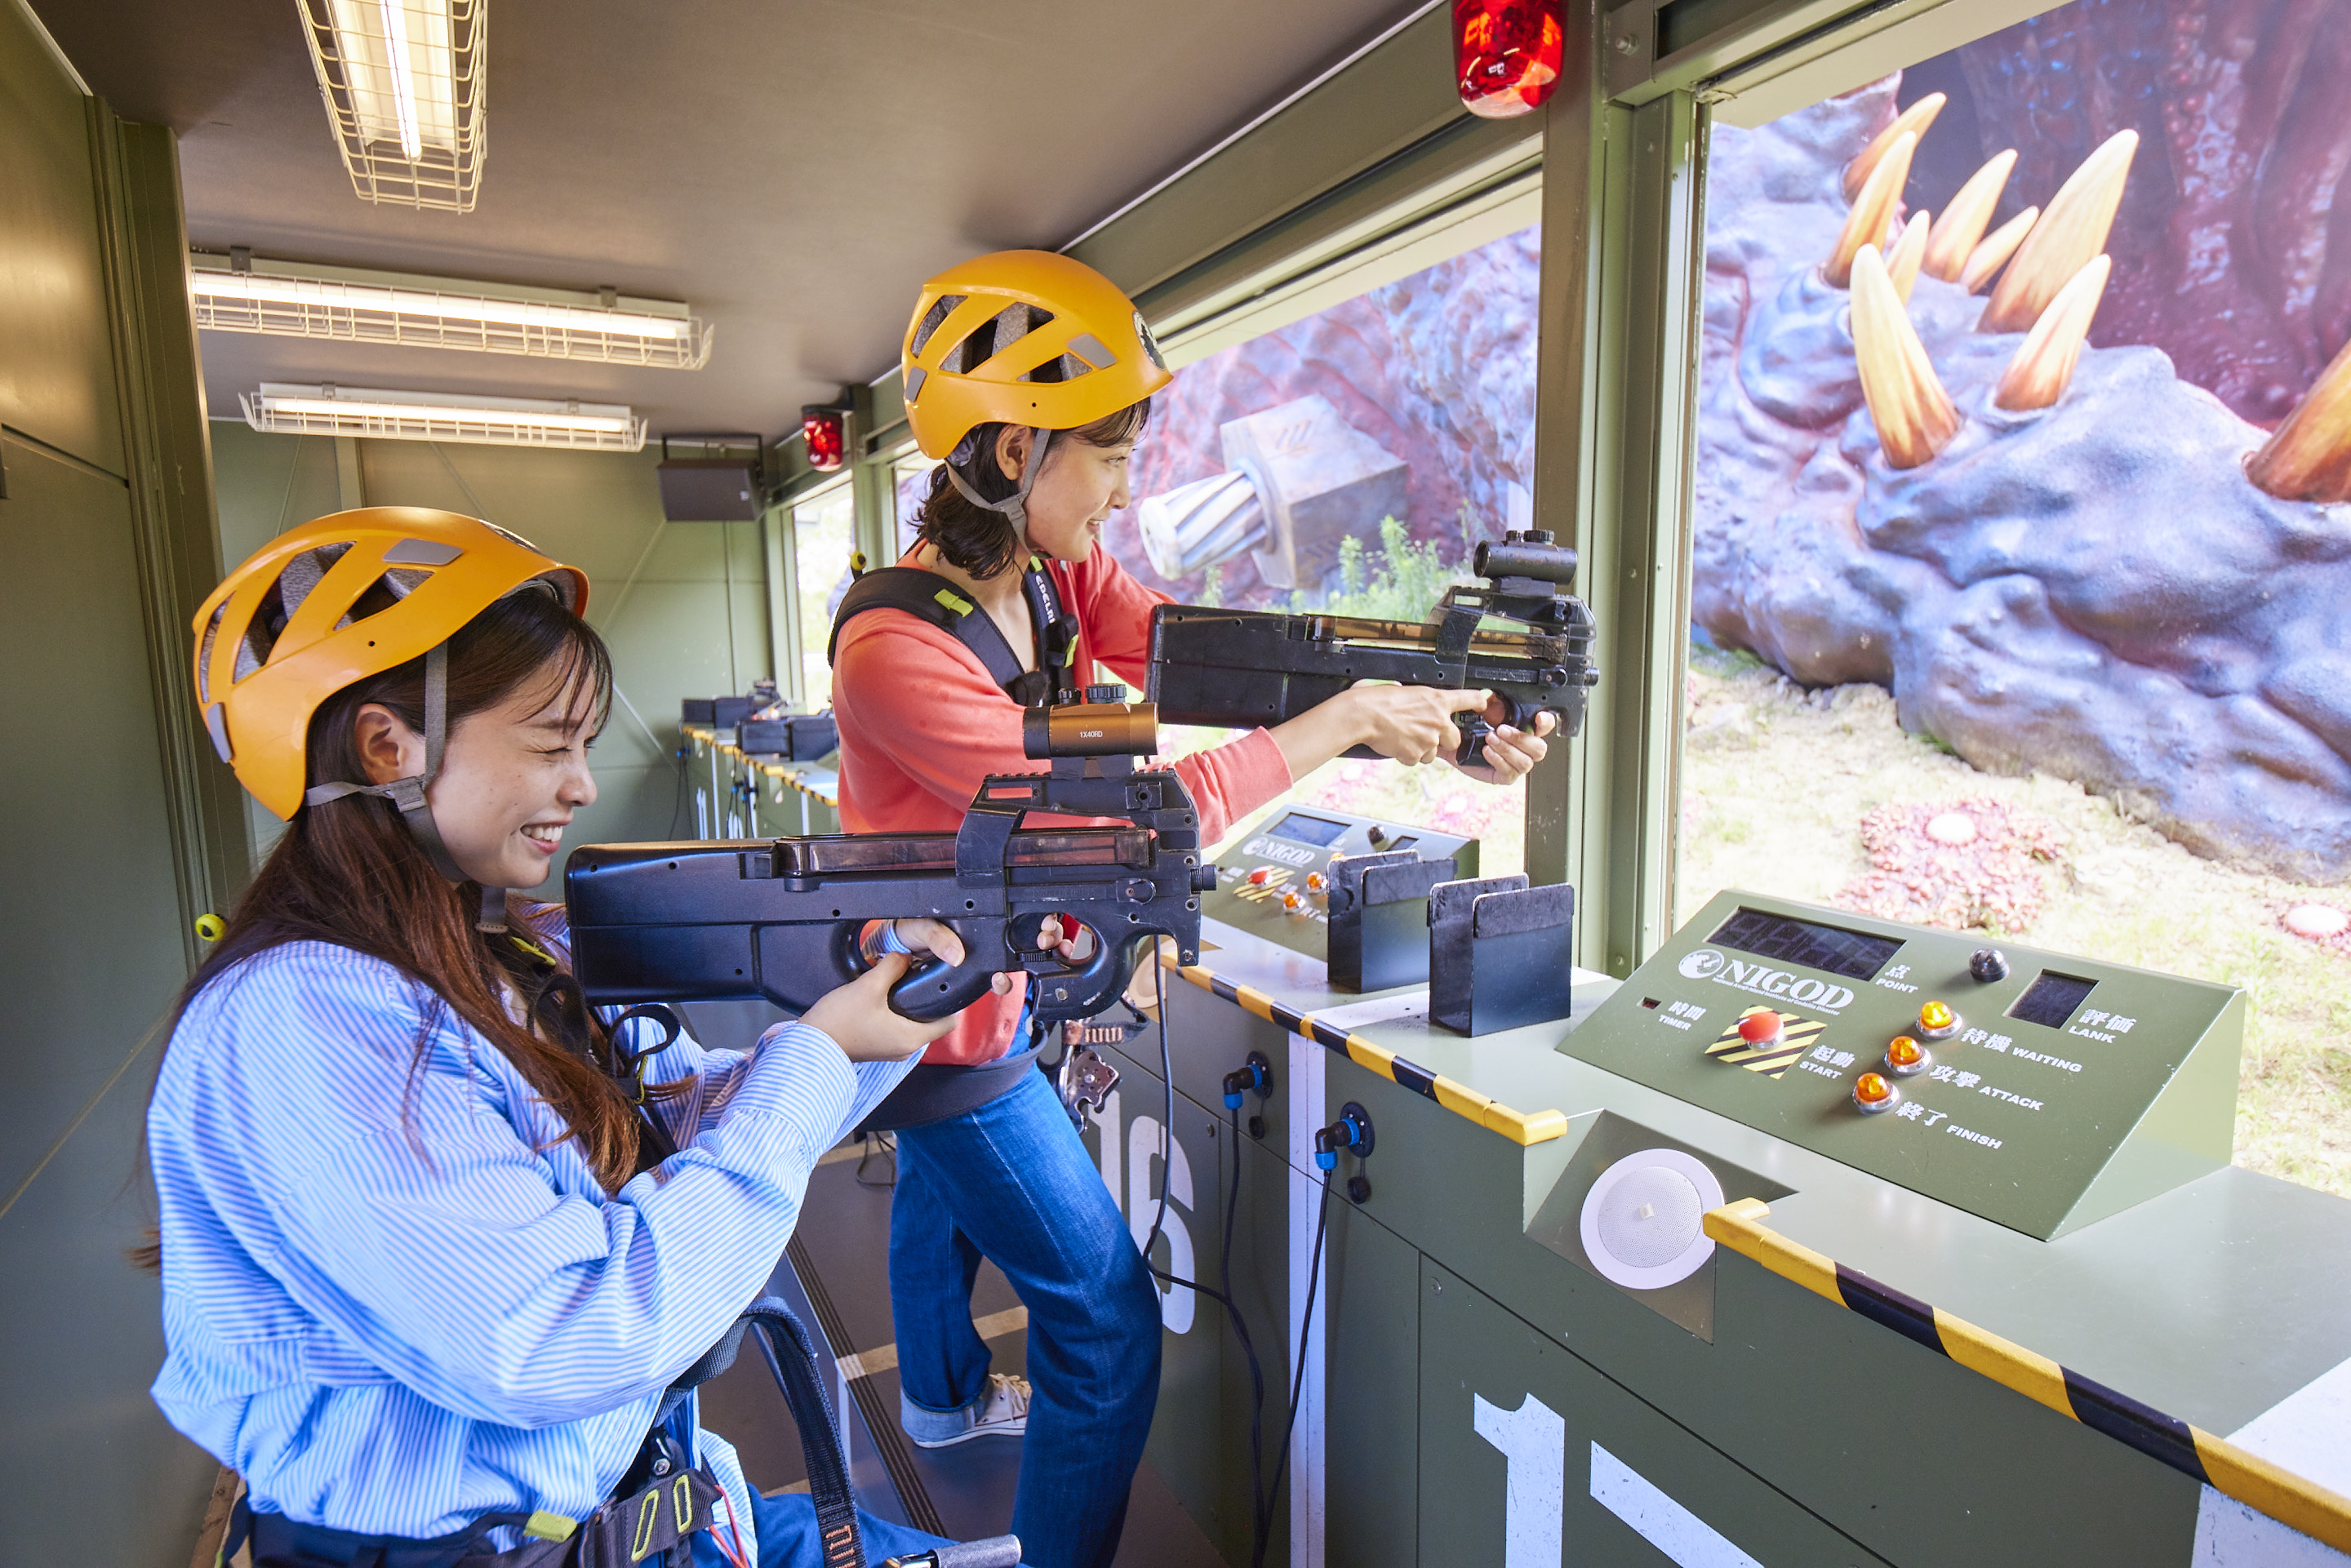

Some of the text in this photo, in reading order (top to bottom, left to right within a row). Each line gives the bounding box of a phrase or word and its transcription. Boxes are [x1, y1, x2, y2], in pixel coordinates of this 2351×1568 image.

[1886, 964, 1910, 979] 点
[1715, 959, 1854, 1008] NIGOD
[1876, 979, 1918, 993] POINT
[1668, 1001, 1707, 1020] 時間
[2078, 1009, 2136, 1033] 評価
[1658, 1015, 1691, 1030] TIMER
[2068, 1025, 2117, 1043] LANK
[1810, 1045, 1855, 1068] 起動
[1961, 1028, 2082, 1073] 待機 WAITING
[1798, 1060, 1842, 1078] START
[1929, 1065, 2044, 1111] 攻撃 ATTACK
[1895, 1101, 2003, 1149] 終了 FINISH
[1088, 1090, 1195, 1335] 16
